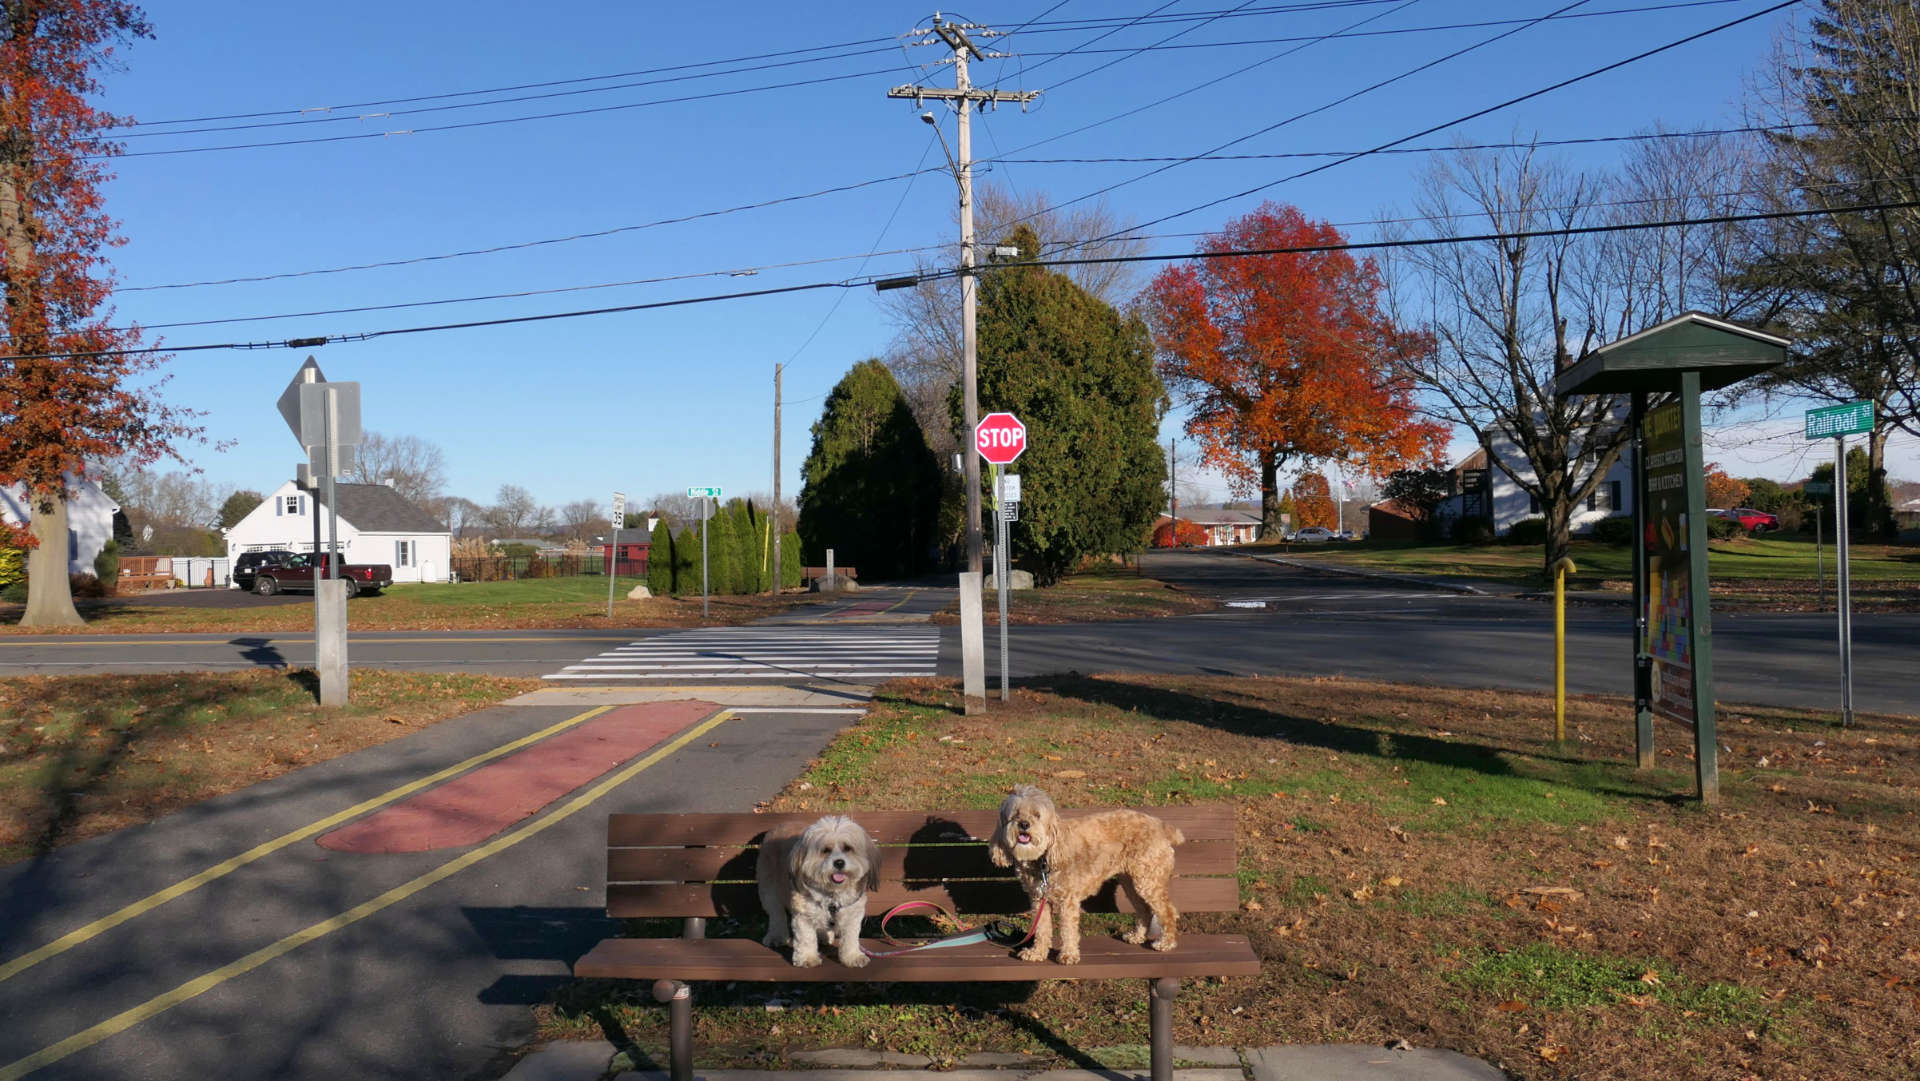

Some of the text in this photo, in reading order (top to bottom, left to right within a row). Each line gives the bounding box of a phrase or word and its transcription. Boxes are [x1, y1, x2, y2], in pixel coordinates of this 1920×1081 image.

[1807, 408, 1857, 435] Railroad
[979, 427, 1023, 448] STOP
[613, 511, 622, 525] 35
